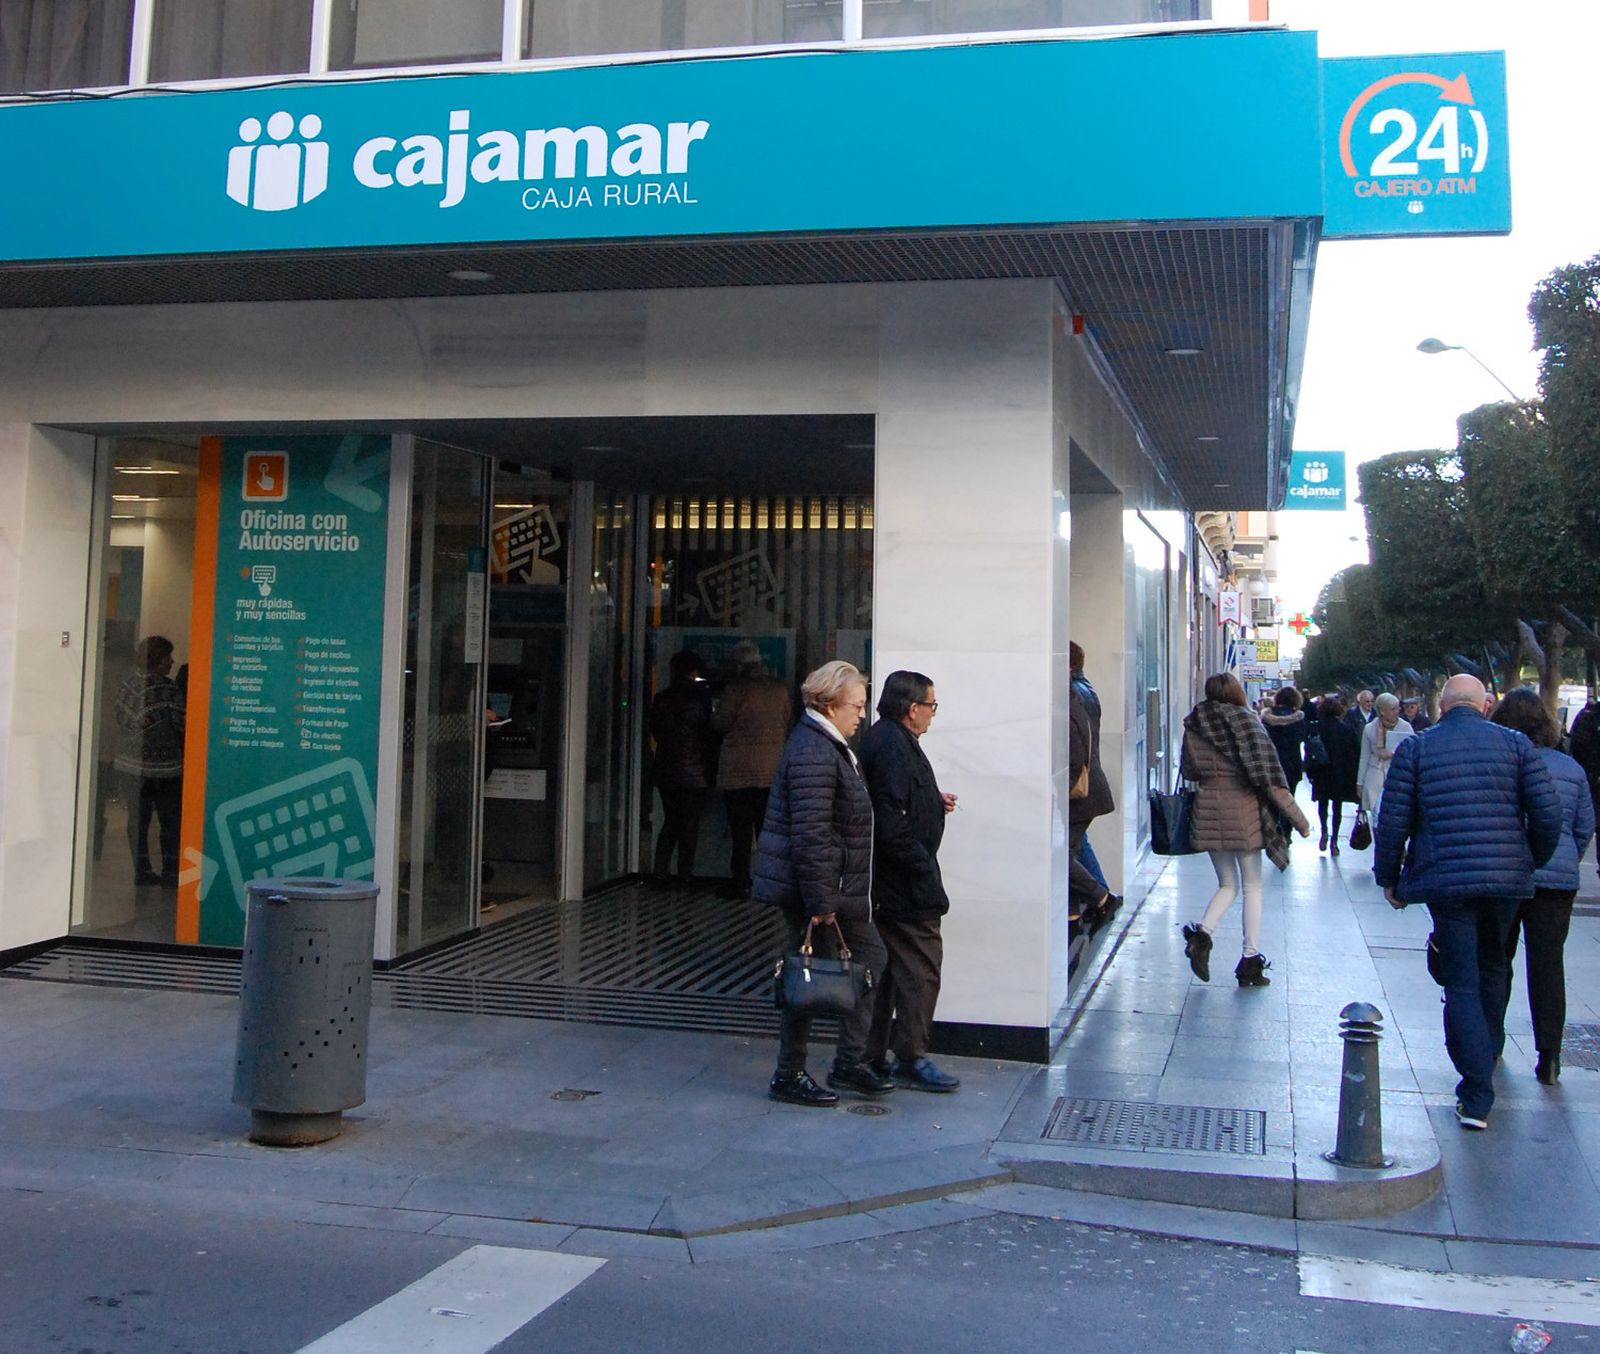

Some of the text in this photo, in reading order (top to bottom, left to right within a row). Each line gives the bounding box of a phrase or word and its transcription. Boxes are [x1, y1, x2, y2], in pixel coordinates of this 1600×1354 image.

[353, 109, 710, 209] cajamar
[1354, 176, 1477, 198] CAJERO ATM
[521, 182, 698, 210] CAJA RURAL
[1289, 484, 1342, 499] cajamar
[240, 509, 348, 530] Oficina con
[238, 530, 360, 551] Autoservicio
[236, 597, 293, 610] muy rápidas
[235, 609, 307, 621] y muy sencillas
[305, 636, 320, 645] Pago
[304, 650, 320, 659] Pago
[320, 651, 329, 659] de
[304, 663, 319, 673] Pago
[320, 664, 328, 672] de
[326, 692, 334, 700] de
